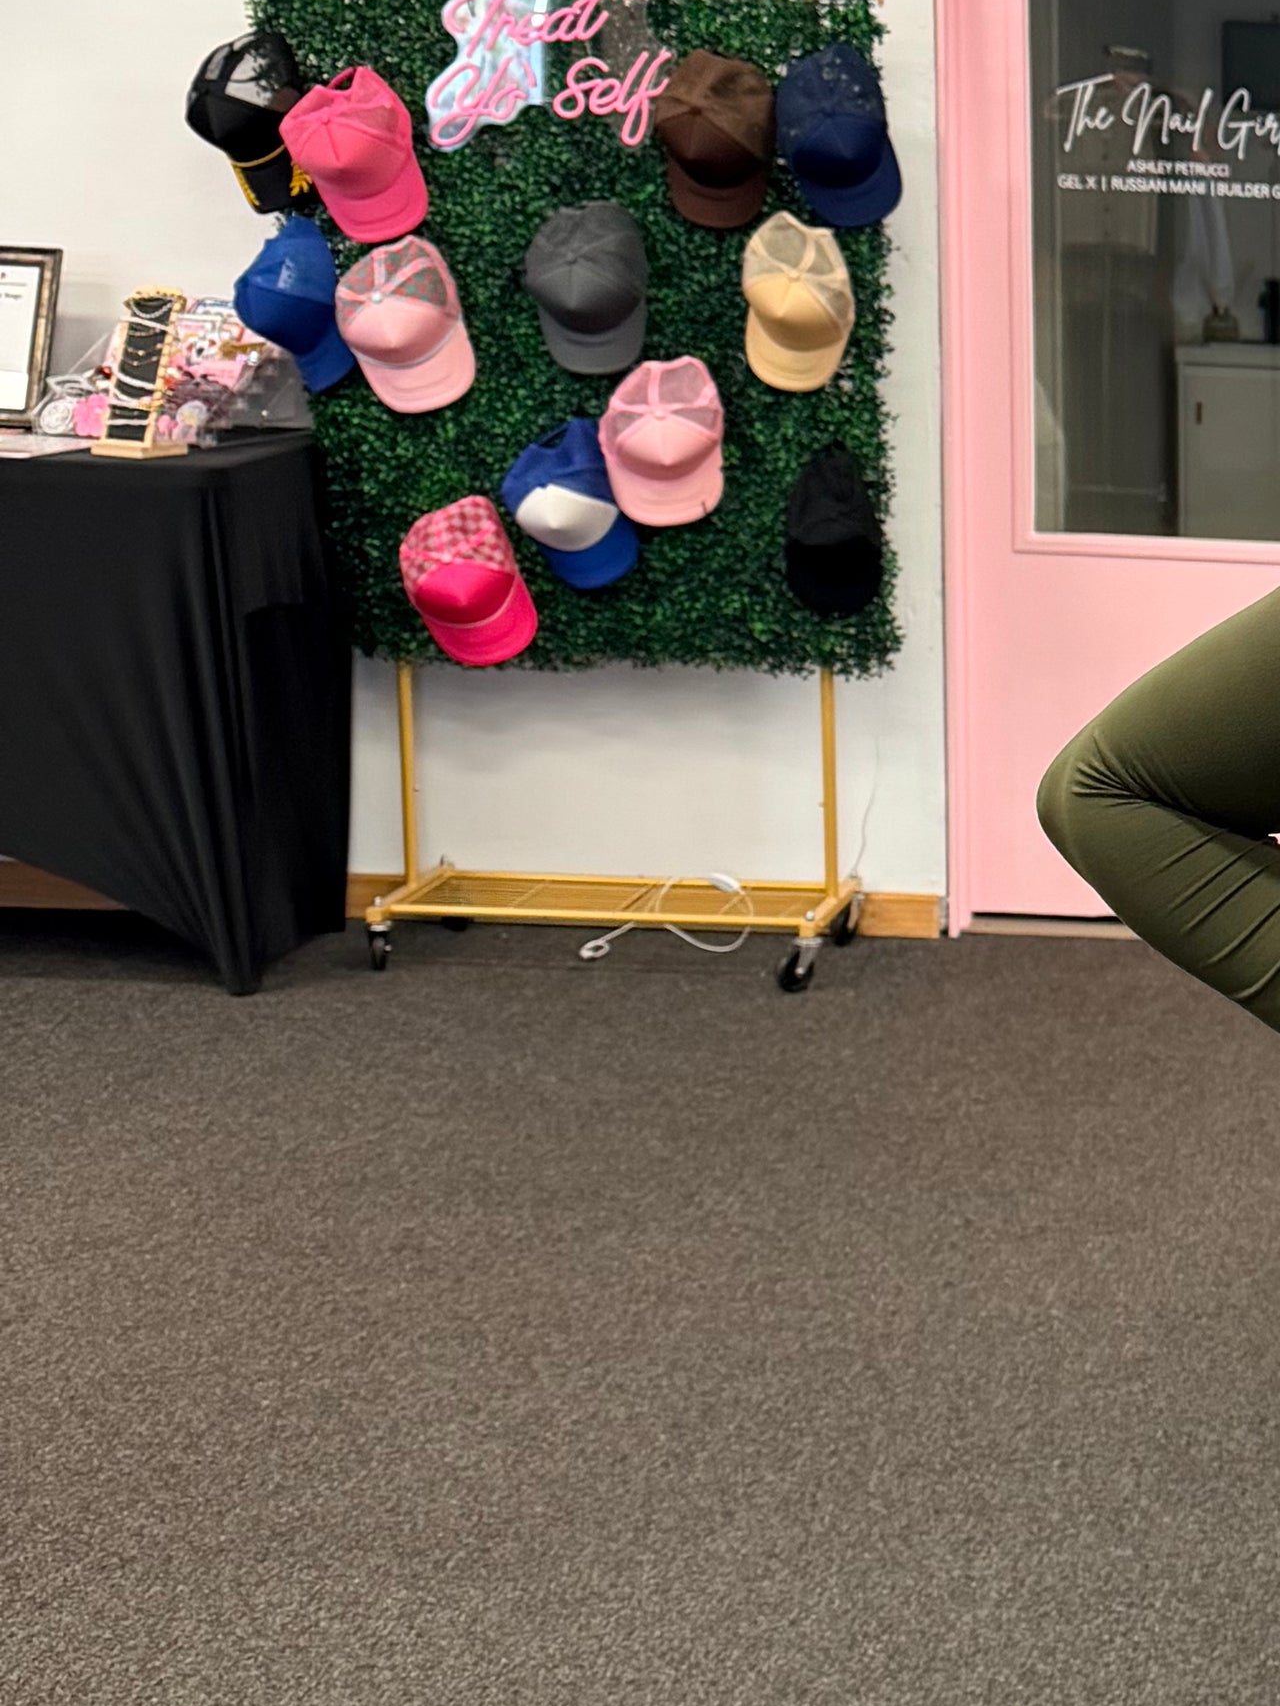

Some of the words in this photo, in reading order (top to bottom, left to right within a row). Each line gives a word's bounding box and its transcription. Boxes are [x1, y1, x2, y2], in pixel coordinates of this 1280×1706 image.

[552, 49, 672, 146] Self
[1055, 73, 1115, 153] The
[1121, 82, 1213, 155] Nail
[1056, 173, 1084, 190] GEL
[1085, 173, 1098, 190] X
[1110, 175, 1168, 193] RUSSIAN
[1168, 177, 1206, 195] MANI
[1217, 181, 1271, 199] BUILDER
[1126, 159, 1173, 175] ASHLEY
[1174, 161, 1230, 178] PETRUCCI
